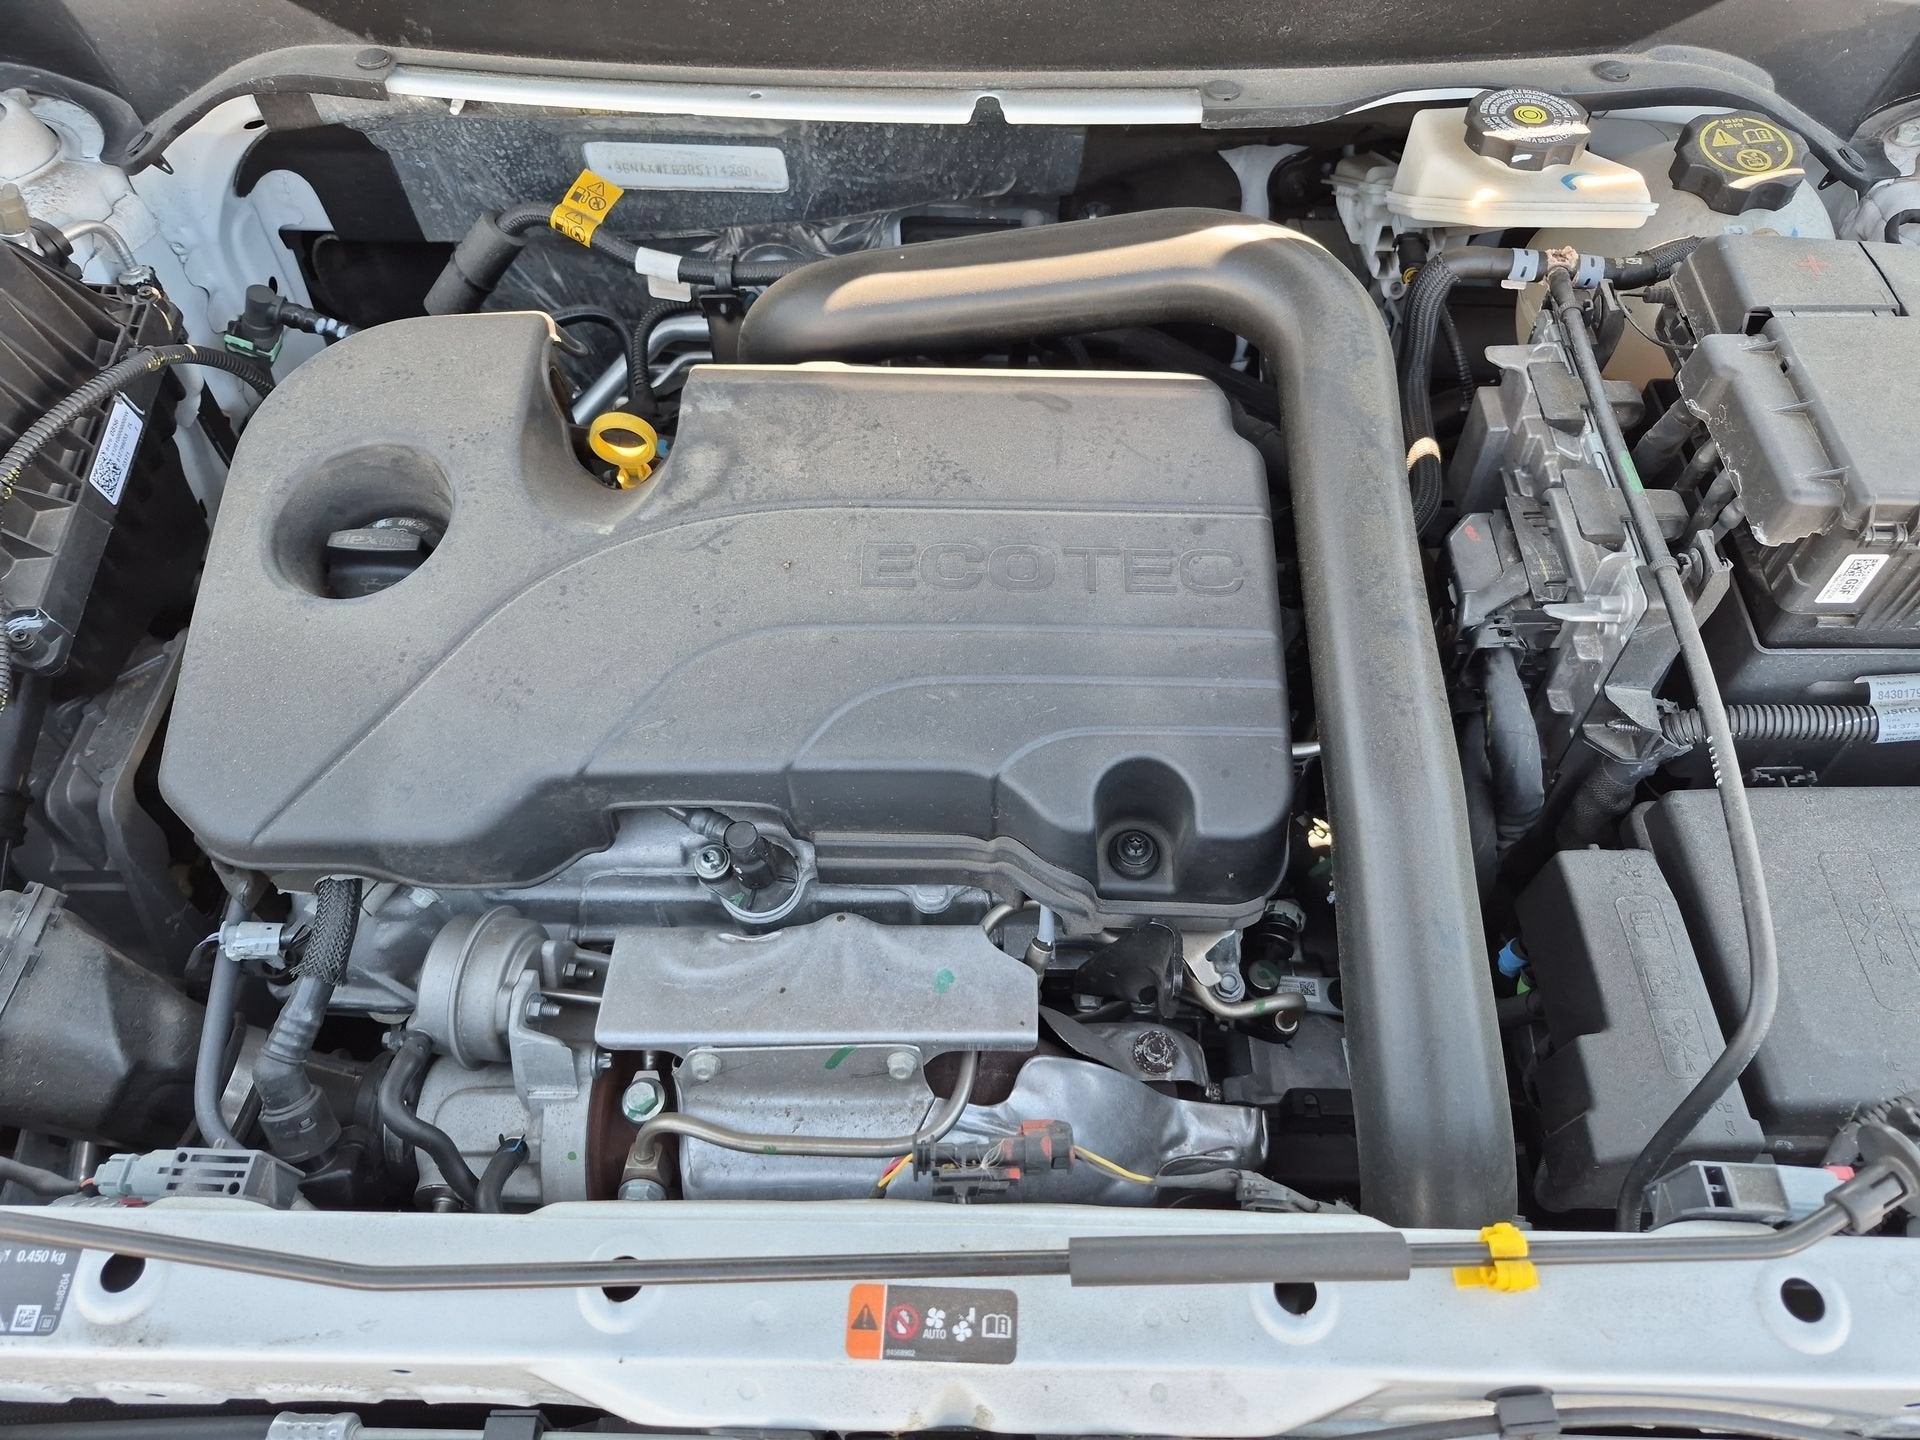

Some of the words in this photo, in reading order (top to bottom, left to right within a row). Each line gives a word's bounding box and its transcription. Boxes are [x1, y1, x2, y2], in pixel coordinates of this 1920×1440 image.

[860, 542, 1244, 597] ECOTEC
[1840, 578, 1859, 595] G5F
[16, 1249, 50, 1263] 0.450
[50, 1249, 67, 1266] kg
[922, 1328, 947, 1340] AUTO
